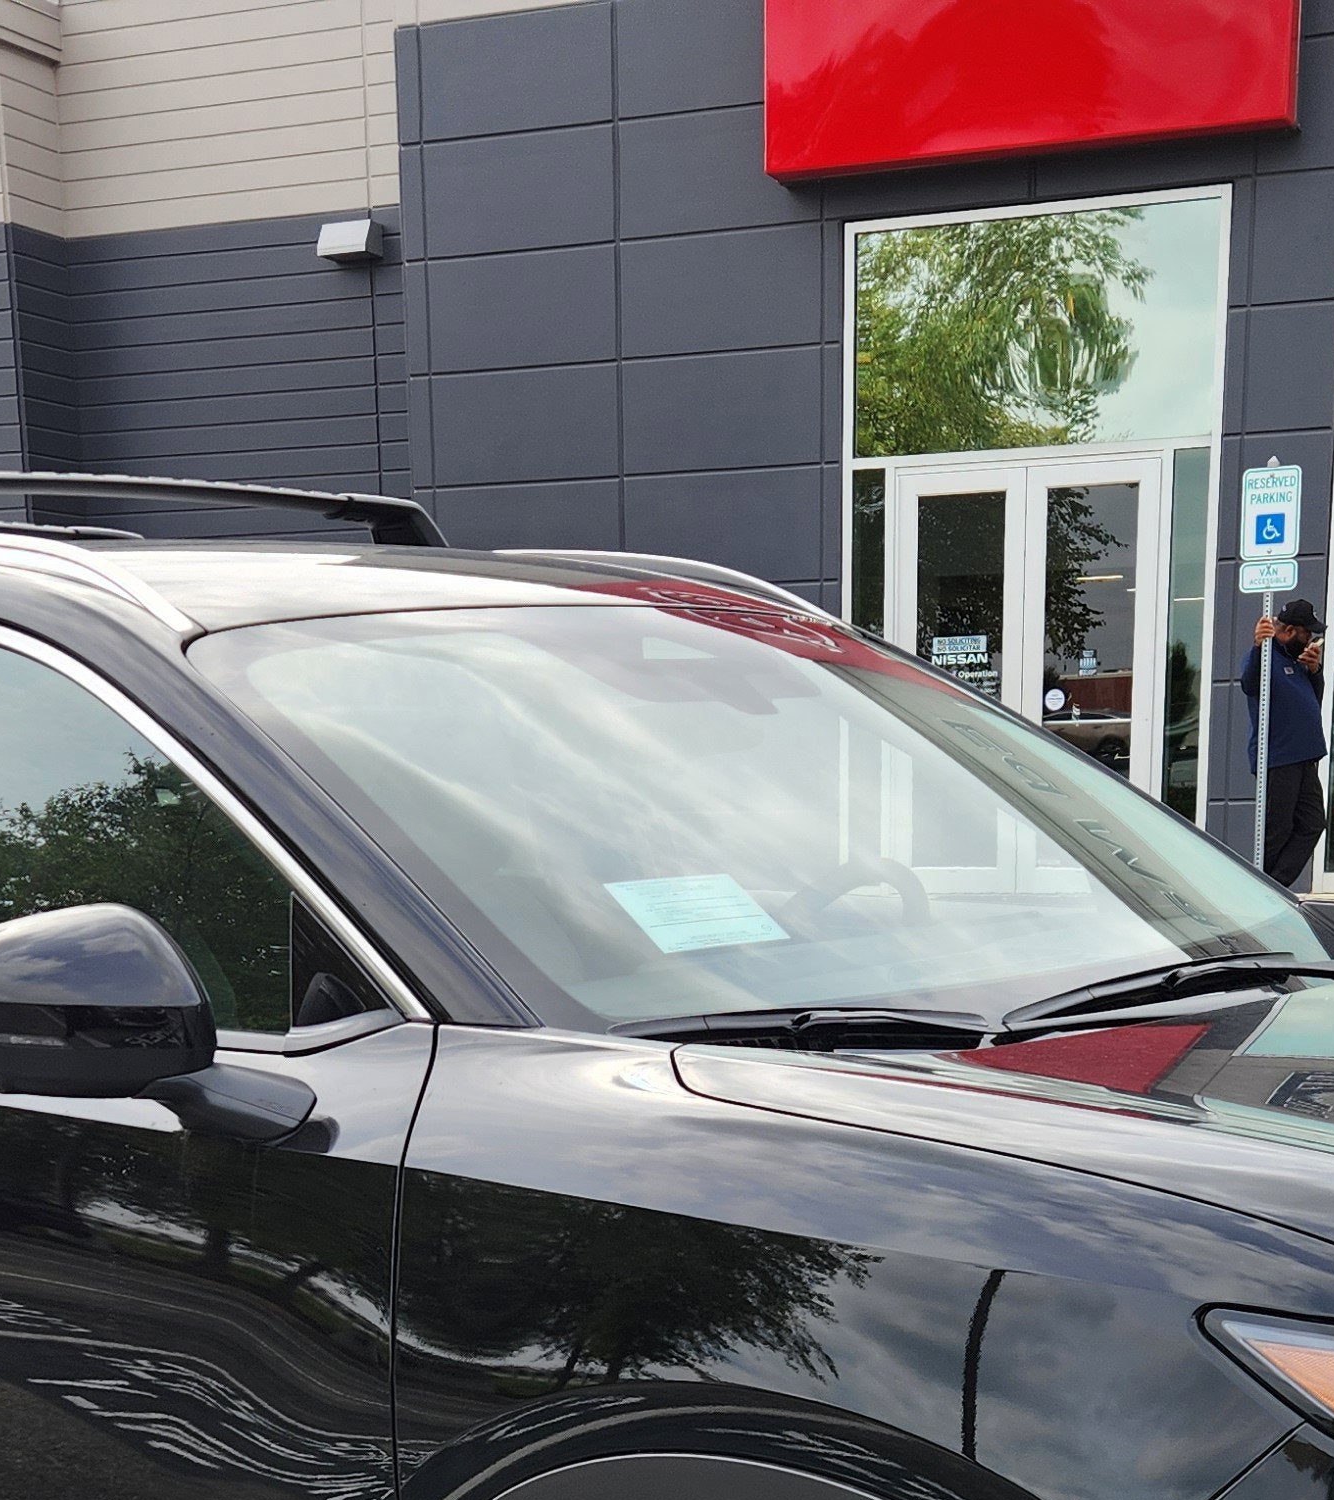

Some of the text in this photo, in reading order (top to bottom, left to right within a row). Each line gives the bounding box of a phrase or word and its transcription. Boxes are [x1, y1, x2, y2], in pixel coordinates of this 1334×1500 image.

[1246, 475, 1297, 490] RESERVED
[1249, 491, 1293, 505] PARKING
[1259, 567, 1279, 577] VAN
[931, 653, 988, 666] NISSAN
[957, 669, 998, 680] Operation
